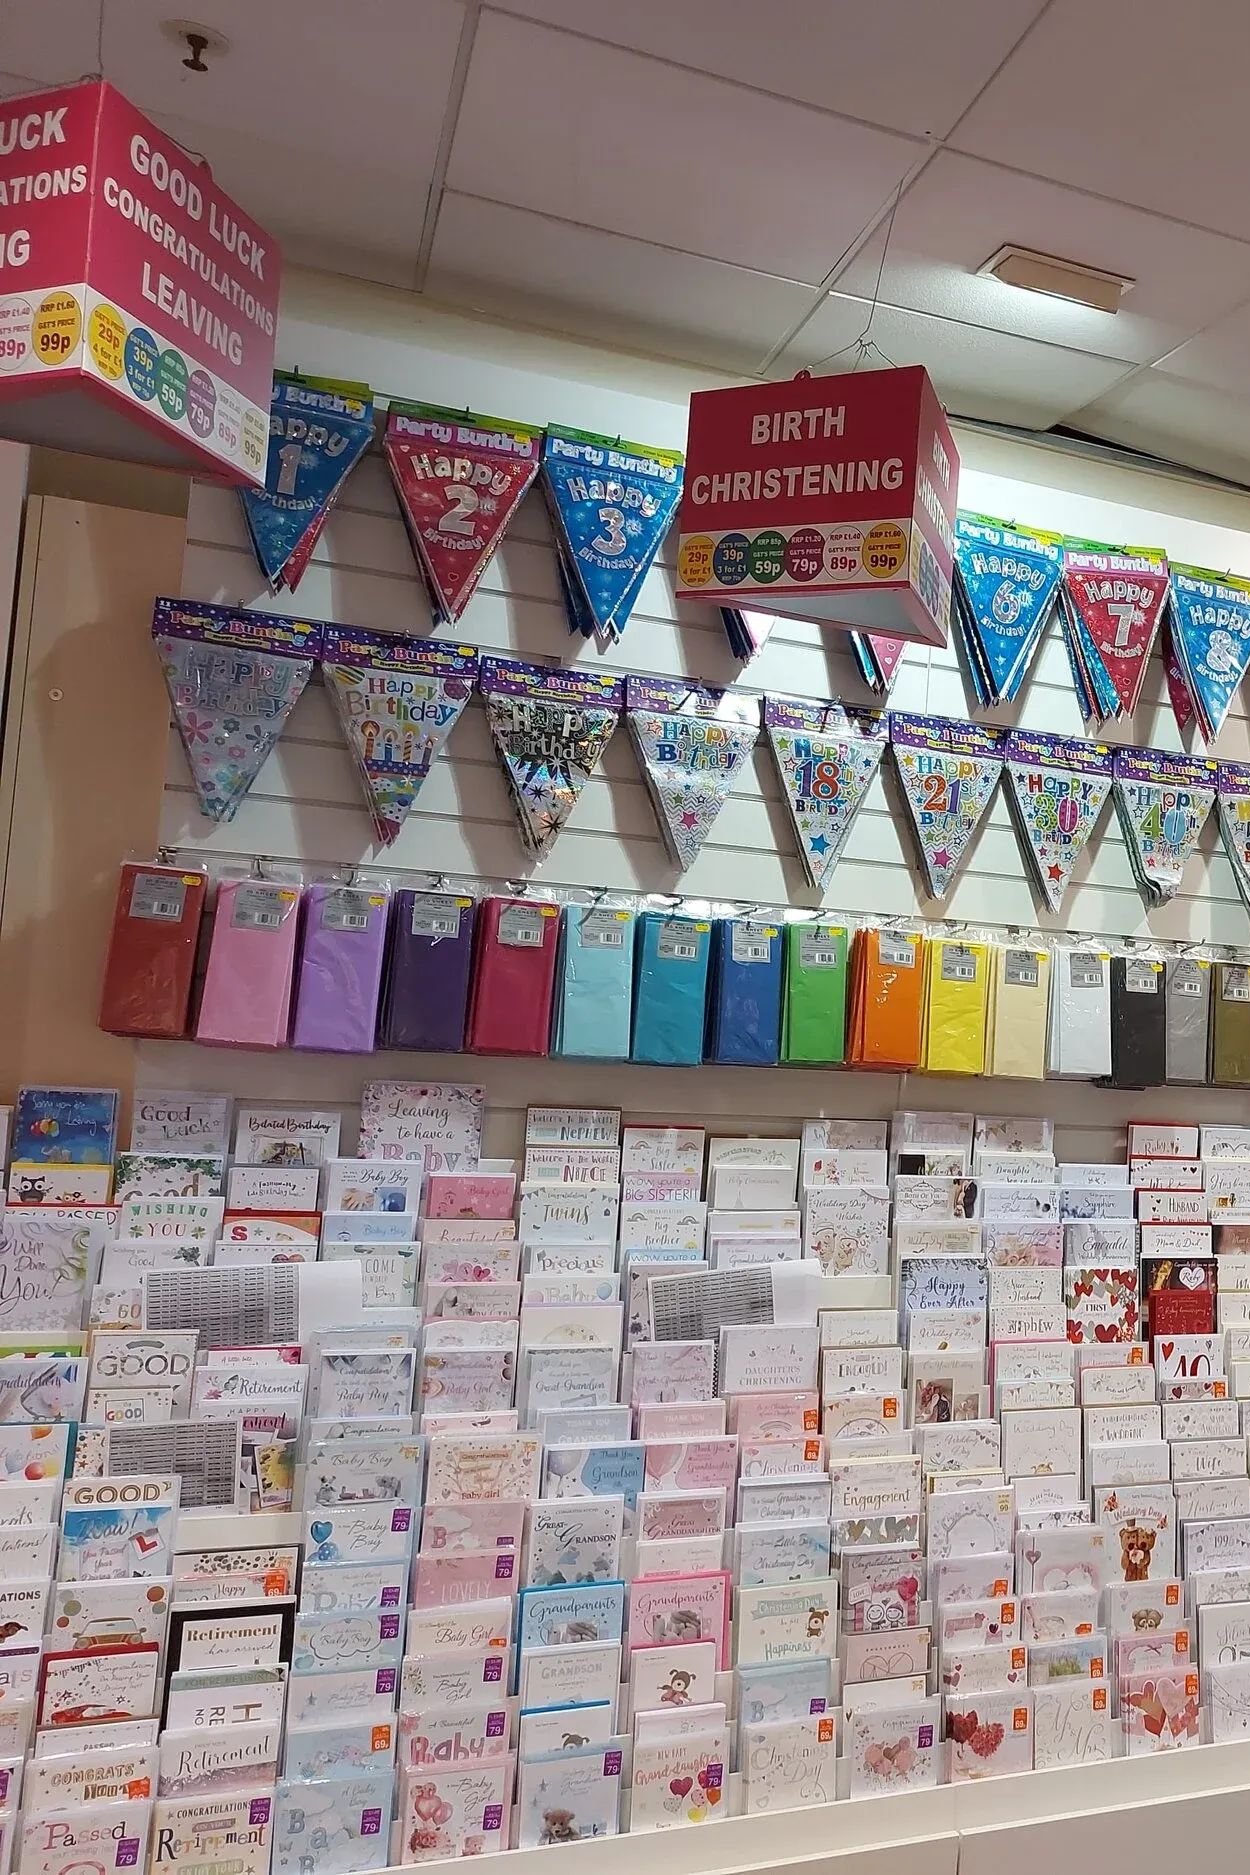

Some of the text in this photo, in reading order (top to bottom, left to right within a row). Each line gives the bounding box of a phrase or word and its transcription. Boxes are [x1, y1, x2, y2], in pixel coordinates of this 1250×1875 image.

[130, 134, 265, 281] GOOD LUCK
[103, 177, 274, 337] CONGRATULATIONS
[142, 262, 243, 366] LEAVING
[40, 333, 70, 353] 99p
[98, 324, 120, 350] 29p
[133, 347, 153, 371] 39p
[161, 384, 182, 413] 59p
[191, 403, 210, 430] 79p
[751, 406, 845, 444] BIRTH
[218, 422, 236, 448] 89p
[396, 417, 453, 443] Party
[244, 441, 261, 464] 99p
[552, 438, 677, 483] Party Bunting
[932, 430, 950, 491] BIRTH
[409, 455, 512, 496] Happy
[691, 458, 903, 504] CHRISTENING
[566, 476, 661, 517] Happy
[959, 520, 1000, 545] Party
[688, 552, 707, 564] 29p
[723, 549, 743, 562] 39p
[791, 559, 818, 574] 79p
[830, 556, 857, 571] 89p
[870, 554, 897, 570] 99p
[1069, 554, 1107, 570] Party
[755, 560, 781, 576] 59p
[971, 554, 1046, 590] Happy
[1084, 580, 1154, 607] Happy
[1178, 576, 1213, 597] Party
[170, 612, 306, 646] Party Bunting
[339, 641, 465, 668] Party Bunting
[367, 677, 438, 700] Happy
[496, 670, 613, 698] Party Bunting
[345, 691, 458, 725] Birthday
[902, 723, 995, 746] Party Bunting
[656, 744, 738, 771] Birthday
[1018, 739, 1103, 765] Party Bunting
[1128, 757, 1207, 779] Party Bunting
[141, 1106, 191, 1121] Good
[388, 1099, 451, 1127] Leaving
[163, 1119, 210, 1139] Luck
[249, 1117, 331, 1133] Belated Birthday
[397, 1126, 442, 1140] to have
[359, 1167, 409, 1185] Baby Boy
[625, 1188, 645, 1200] BIG
[131, 1204, 208, 1217] WISHING
[543, 1203, 590, 1225] Twins
[147, 1223, 186, 1237] YOU
[925, 1276, 965, 1292] Happy
[97, 1354, 190, 1378] GOOD
[239, 1376, 302, 1395] Retirement
[107, 1408, 142, 1421] GOOD
[592, 1468, 639, 1479] Grandson
[1196, 1456, 1223, 1471] Wife
[74, 1484, 160, 1505] GOOD
[843, 1490, 911, 1509] Engagement
[1114, 1507, 1146, 1519] Wedding
[348, 1521, 386, 1535] Baby
[557, 1520, 617, 1548] GRANDSON
[136, 1533, 157, 1552] L
[351, 1535, 383, 1549] Boy
[217, 1584, 246, 1596] Happy
[638, 1590, 718, 1609] Grandparents
[530, 1598, 616, 1621] Grandparents
[187, 1624, 278, 1641] Retirement
[435, 1625, 494, 1644] Baby Girl
[541, 1663, 602, 1680] GRANDSON
[178, 1736, 270, 1776] Retirement
[410, 1732, 485, 1764] Baby
[51, 1763, 135, 1786] CONGRATS
[459, 1779, 495, 1794] Baby
[177, 1802, 251, 1818] CONGRATULATIONS
[465, 1792, 496, 1812] Girl
[42, 1822, 127, 1850] Passed
